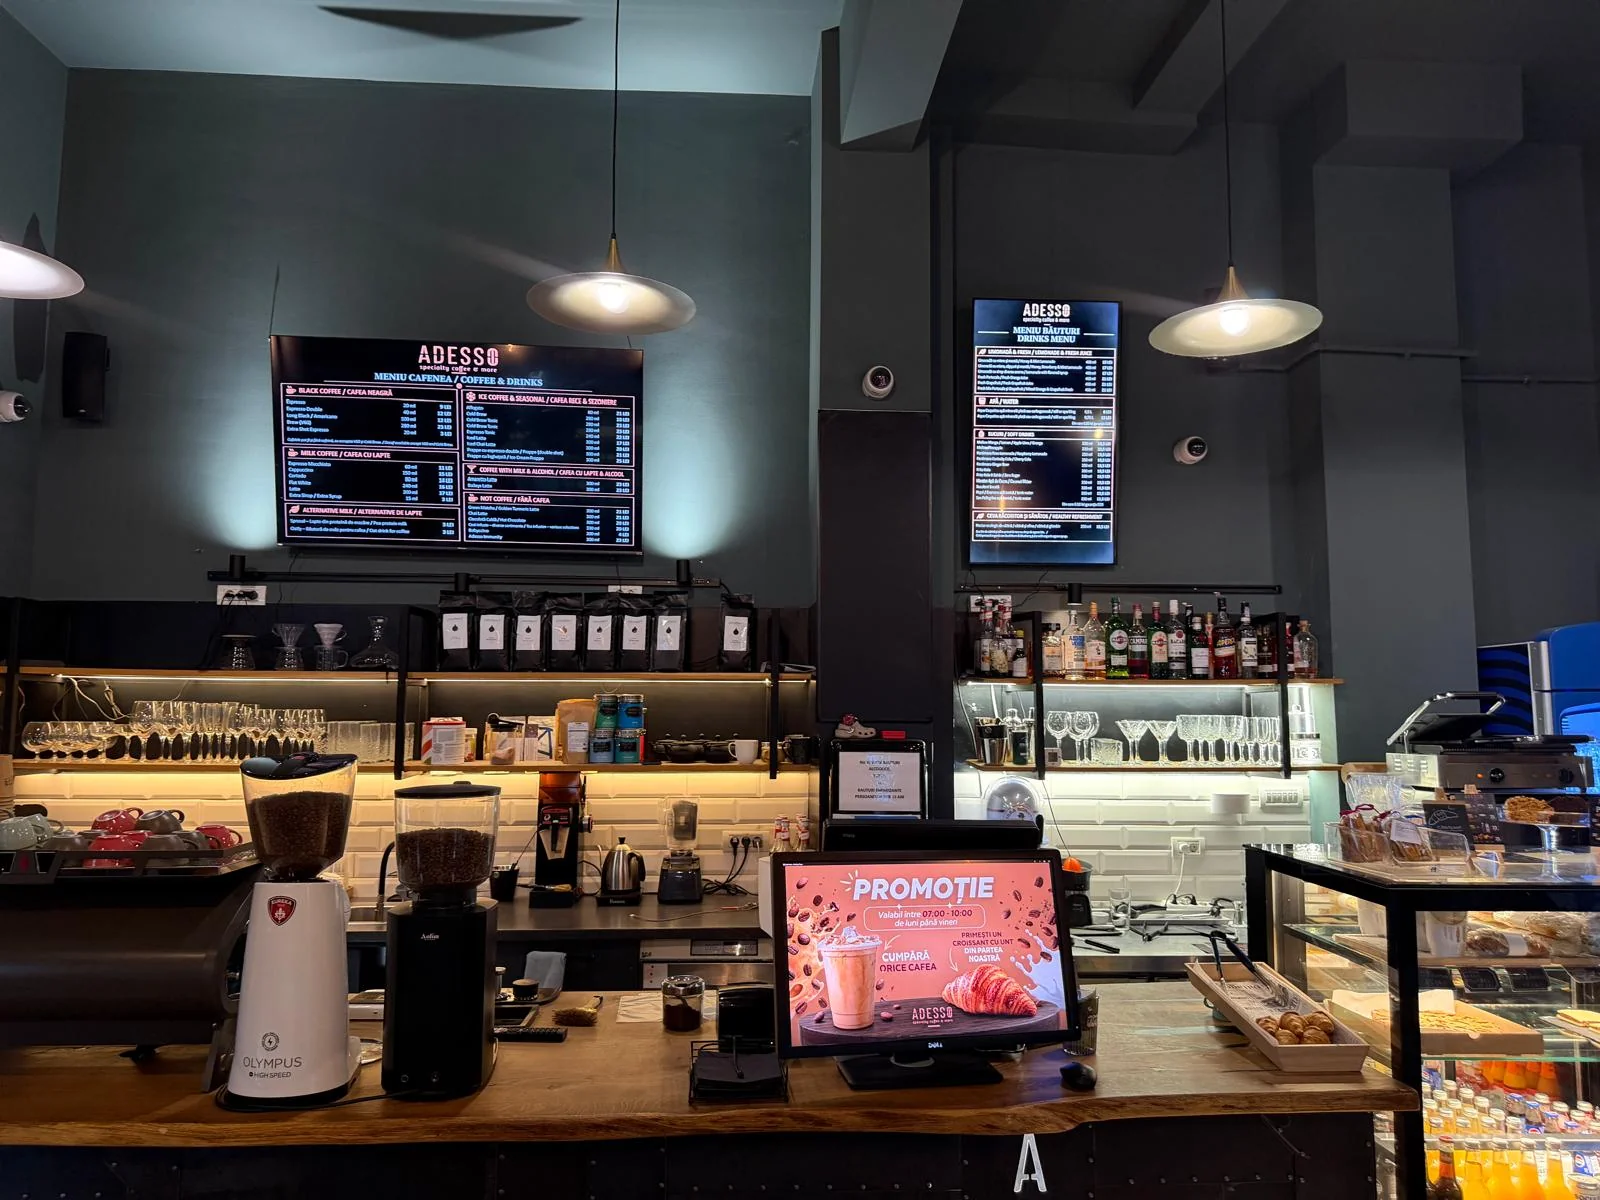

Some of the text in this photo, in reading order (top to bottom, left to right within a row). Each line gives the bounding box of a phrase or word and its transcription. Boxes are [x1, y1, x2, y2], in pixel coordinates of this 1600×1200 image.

[1023, 303, 1070, 317] ADESSO
[1013, 326, 1080, 335] MENIU BĂUTURI
[418, 345, 499, 366] ADESSO
[374, 372, 407, 381] MENIU
[409, 374, 451, 383] CAFENEA
[460, 376, 496, 384] COFFEE
[507, 378, 543, 386] DRINKS
[853, 876, 994, 904] PROMOȚIE
[882, 950, 930, 962] CUMPĂRĂ
[968, 954, 1000, 962] NOASTRĂ
[880, 963, 936, 972] ORICE CAFEA
[912, 1007, 952, 1019] ADESSO
[243, 1057, 302, 1068] OLYMPUS
[1014, 1133, 1047, 1192] A
